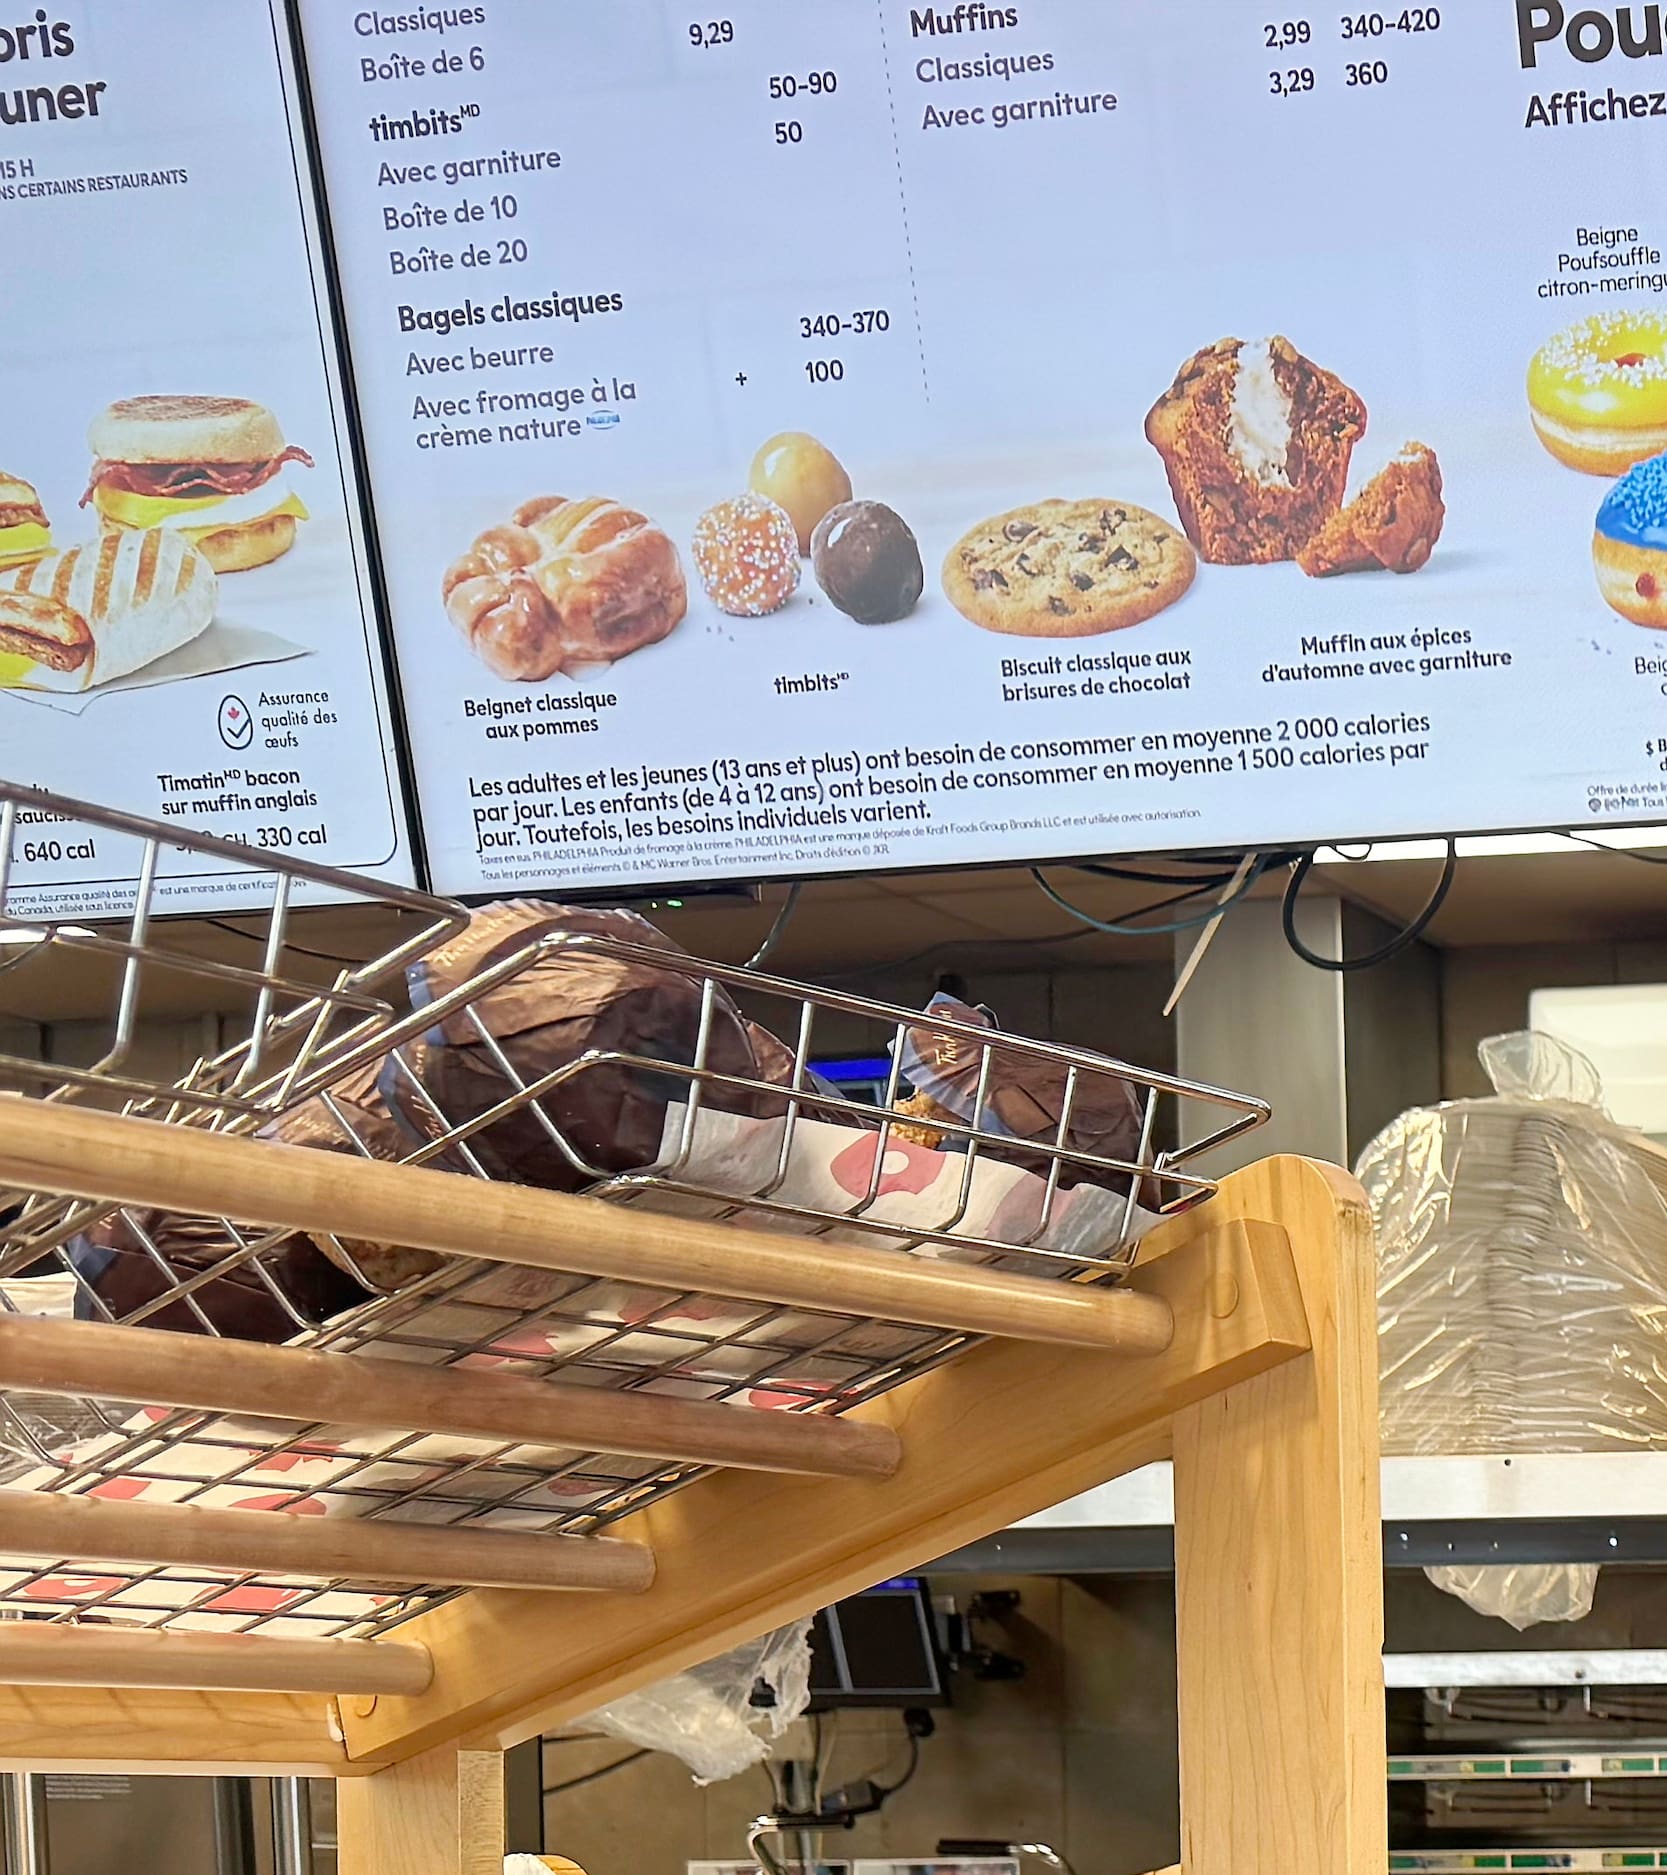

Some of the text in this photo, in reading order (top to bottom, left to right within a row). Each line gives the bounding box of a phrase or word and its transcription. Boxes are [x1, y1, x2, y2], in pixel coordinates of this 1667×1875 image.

[910, 2, 1018, 38] Muffins
[1263, 7, 1441, 51] 2,99 340-420
[360, 46, 485, 83] Boîte de 6
[915, 52, 1055, 83] Classiques
[1269, 60, 1388, 98] 3,29 360
[769, 71, 837, 99] 50-90
[922, 91, 1118, 131] Avec garniture
[1524, 87, 1667, 129] Affichez
[775, 121, 803, 145] 50
[377, 149, 561, 187] Avec garniture
[382, 194, 518, 231] Boîte de 10
[1576, 226, 1639, 249] Beigne
[1558, 245, 1661, 273] Poufsouffle
[397, 290, 623, 336] Bagels classiques
[799, 309, 890, 339] 340-370
[405, 346, 554, 377] Avec beurre
[805, 359, 844, 384] 100
[412, 377, 637, 420] Avec fromage à la
[416, 422, 493, 450] crème
[498, 418, 582, 443] nature
[1300, 627, 1472, 656] Muffin aux épices
[1262, 649, 1512, 683] d'automne avec garniture
[258, 691, 329, 707] Assurance
[463, 690, 617, 720] Beignet classique
[261, 707, 338, 732] qualité des
[485, 718, 599, 742] aux pommes
[264, 730, 299, 749] œufs
[244, 769, 301, 787] bacon
[161, 788, 318, 816] sur muffin anglais
[256, 823, 327, 848] 330 cal
[476, 799, 931, 853] jour. Toutefois, les besoins individuels varient.
[24, 838, 96, 863] 640 cal
